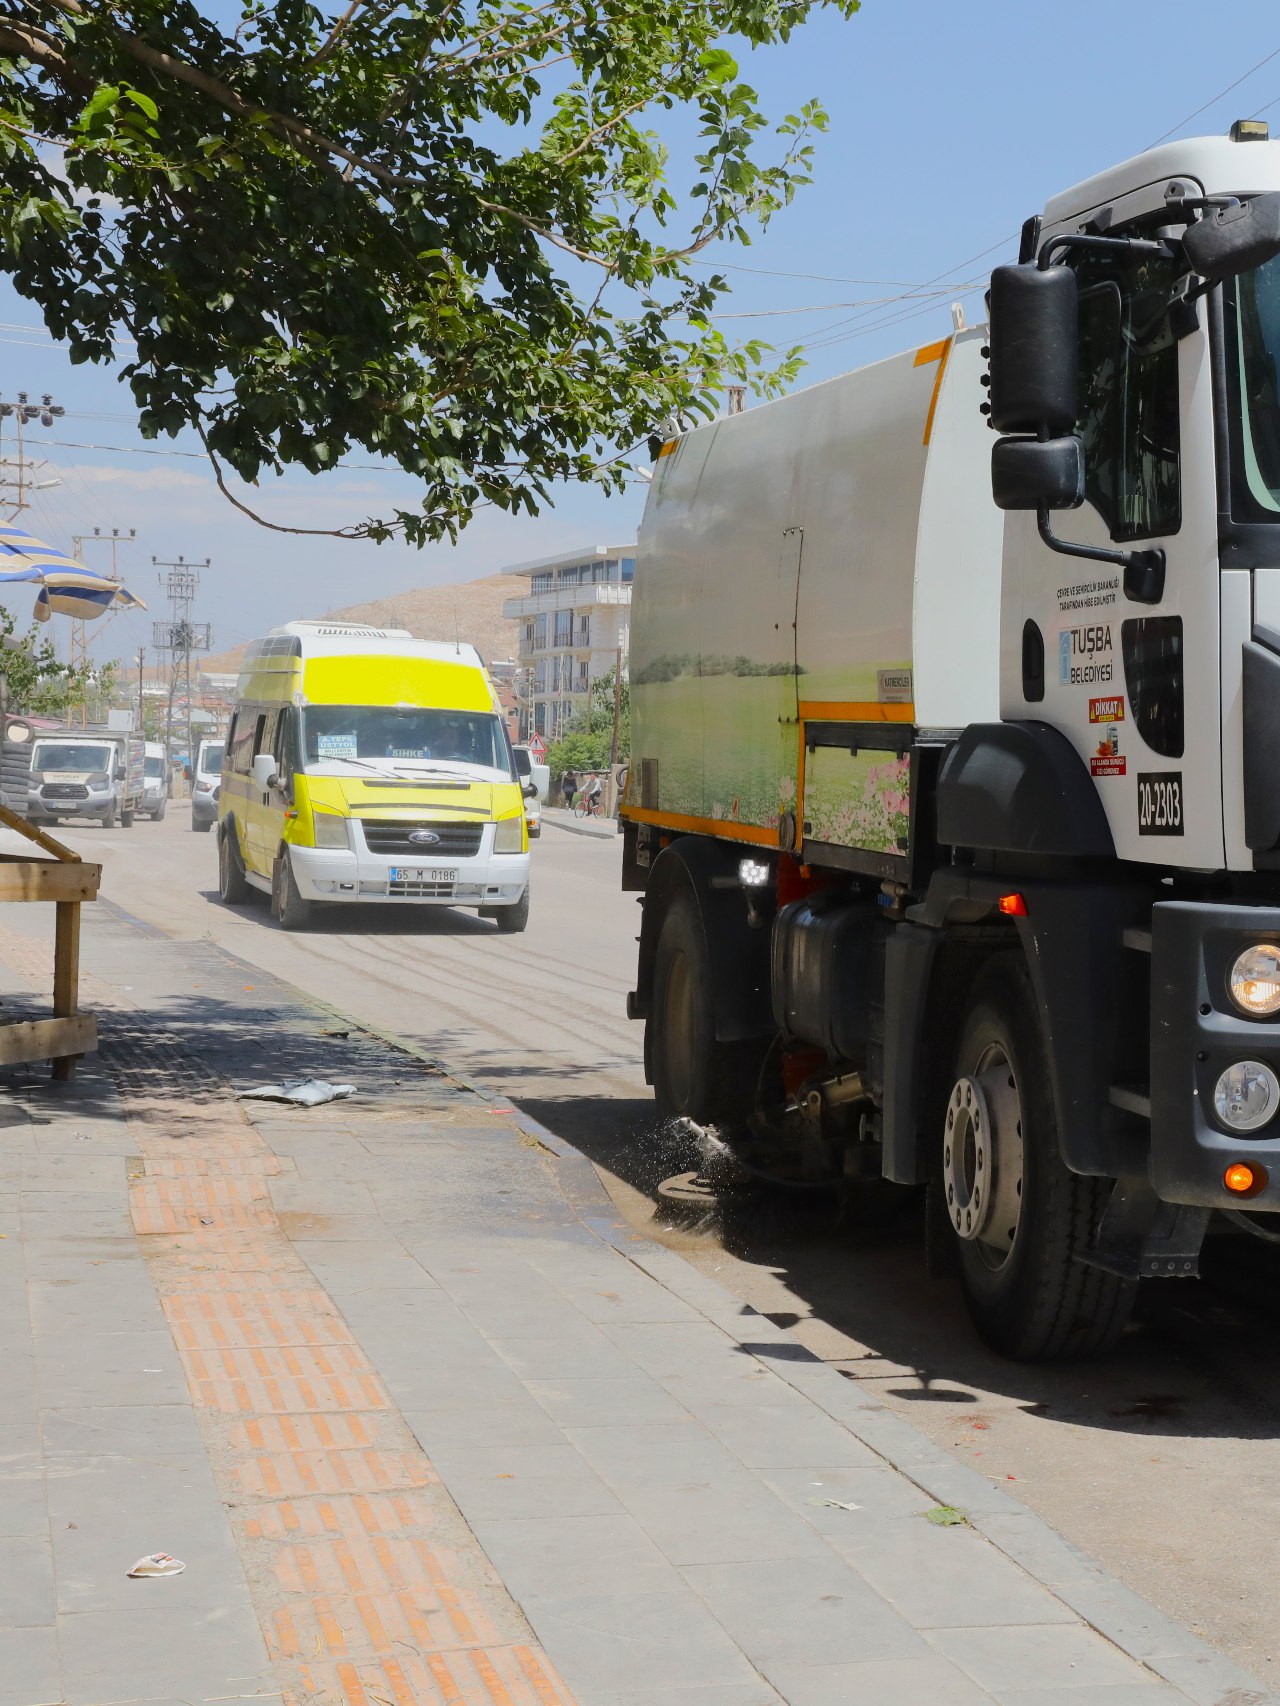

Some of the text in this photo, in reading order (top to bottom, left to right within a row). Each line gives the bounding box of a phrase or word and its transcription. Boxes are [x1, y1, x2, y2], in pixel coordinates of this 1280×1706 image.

[1070, 625, 1113, 660] TUŞBA
[1070, 659, 1113, 684] BELEDİYESİ
[1095, 699, 1118, 716] DİKKAT
[1139, 781, 1181, 827] 20-2303
[396, 870, 409, 880] 65
[416, 870, 424, 880] M
[431, 870, 455, 881] 0186
